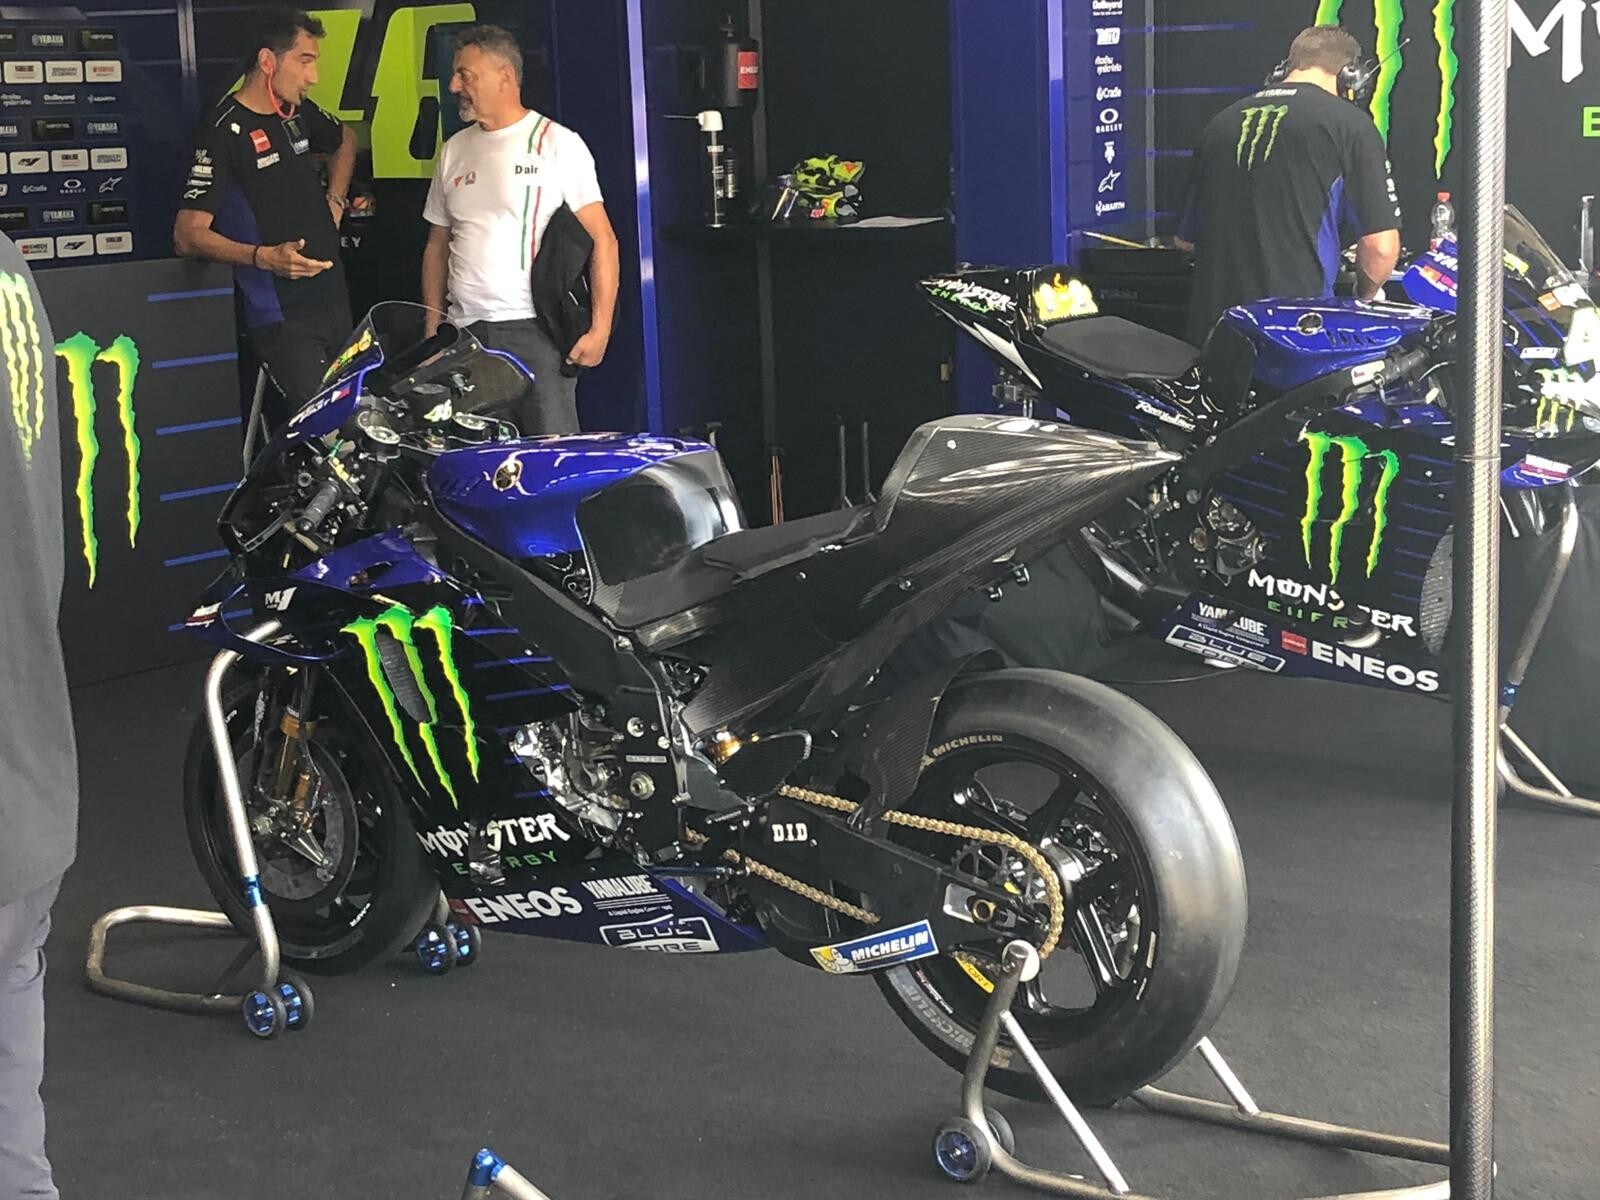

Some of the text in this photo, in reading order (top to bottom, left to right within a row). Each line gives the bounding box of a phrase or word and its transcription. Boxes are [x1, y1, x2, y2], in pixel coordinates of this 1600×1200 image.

[1096, 123, 1123, 134] OAKLEY
[1248, 568, 1417, 638] MONSER
[1199, 602, 1268, 636] YAMUBE
[1312, 640, 1440, 692] ENEOS
[932, 734, 1003, 757] MICHELIN
[452, 850, 558, 875] ERGY
[581, 874, 658, 900] YAMALUBE
[464, 886, 583, 925] ENEOS
[850, 930, 929, 961] MICHELIN
